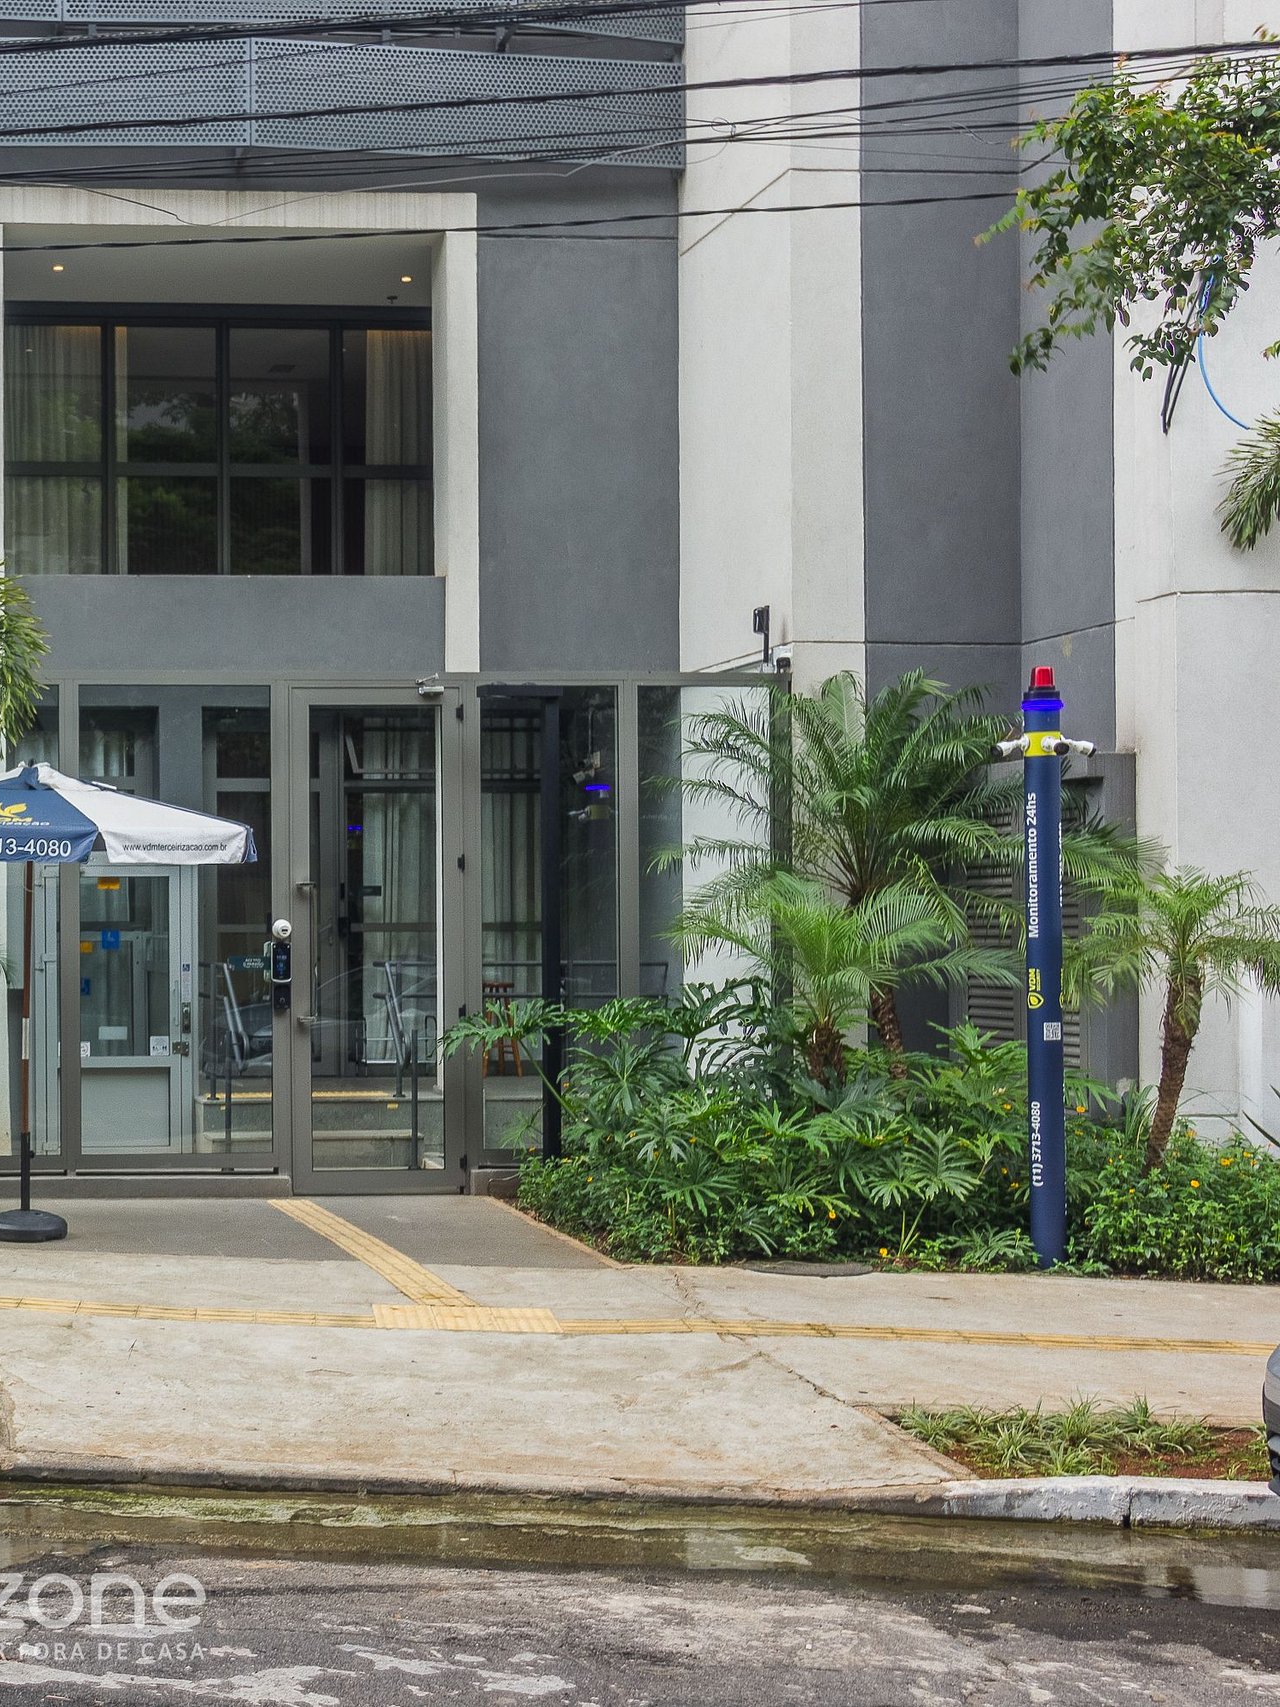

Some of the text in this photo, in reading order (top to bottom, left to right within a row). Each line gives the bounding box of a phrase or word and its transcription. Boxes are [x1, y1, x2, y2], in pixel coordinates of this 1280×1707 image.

[122, 842, 228, 852] www.vdmterceirizacao.com.br
[1025, 792, 1039, 939] Monitoramento 24hs
[1028, 968, 1036, 991] VDM
[1030, 1101, 1044, 1187] (11) 3713-4080
